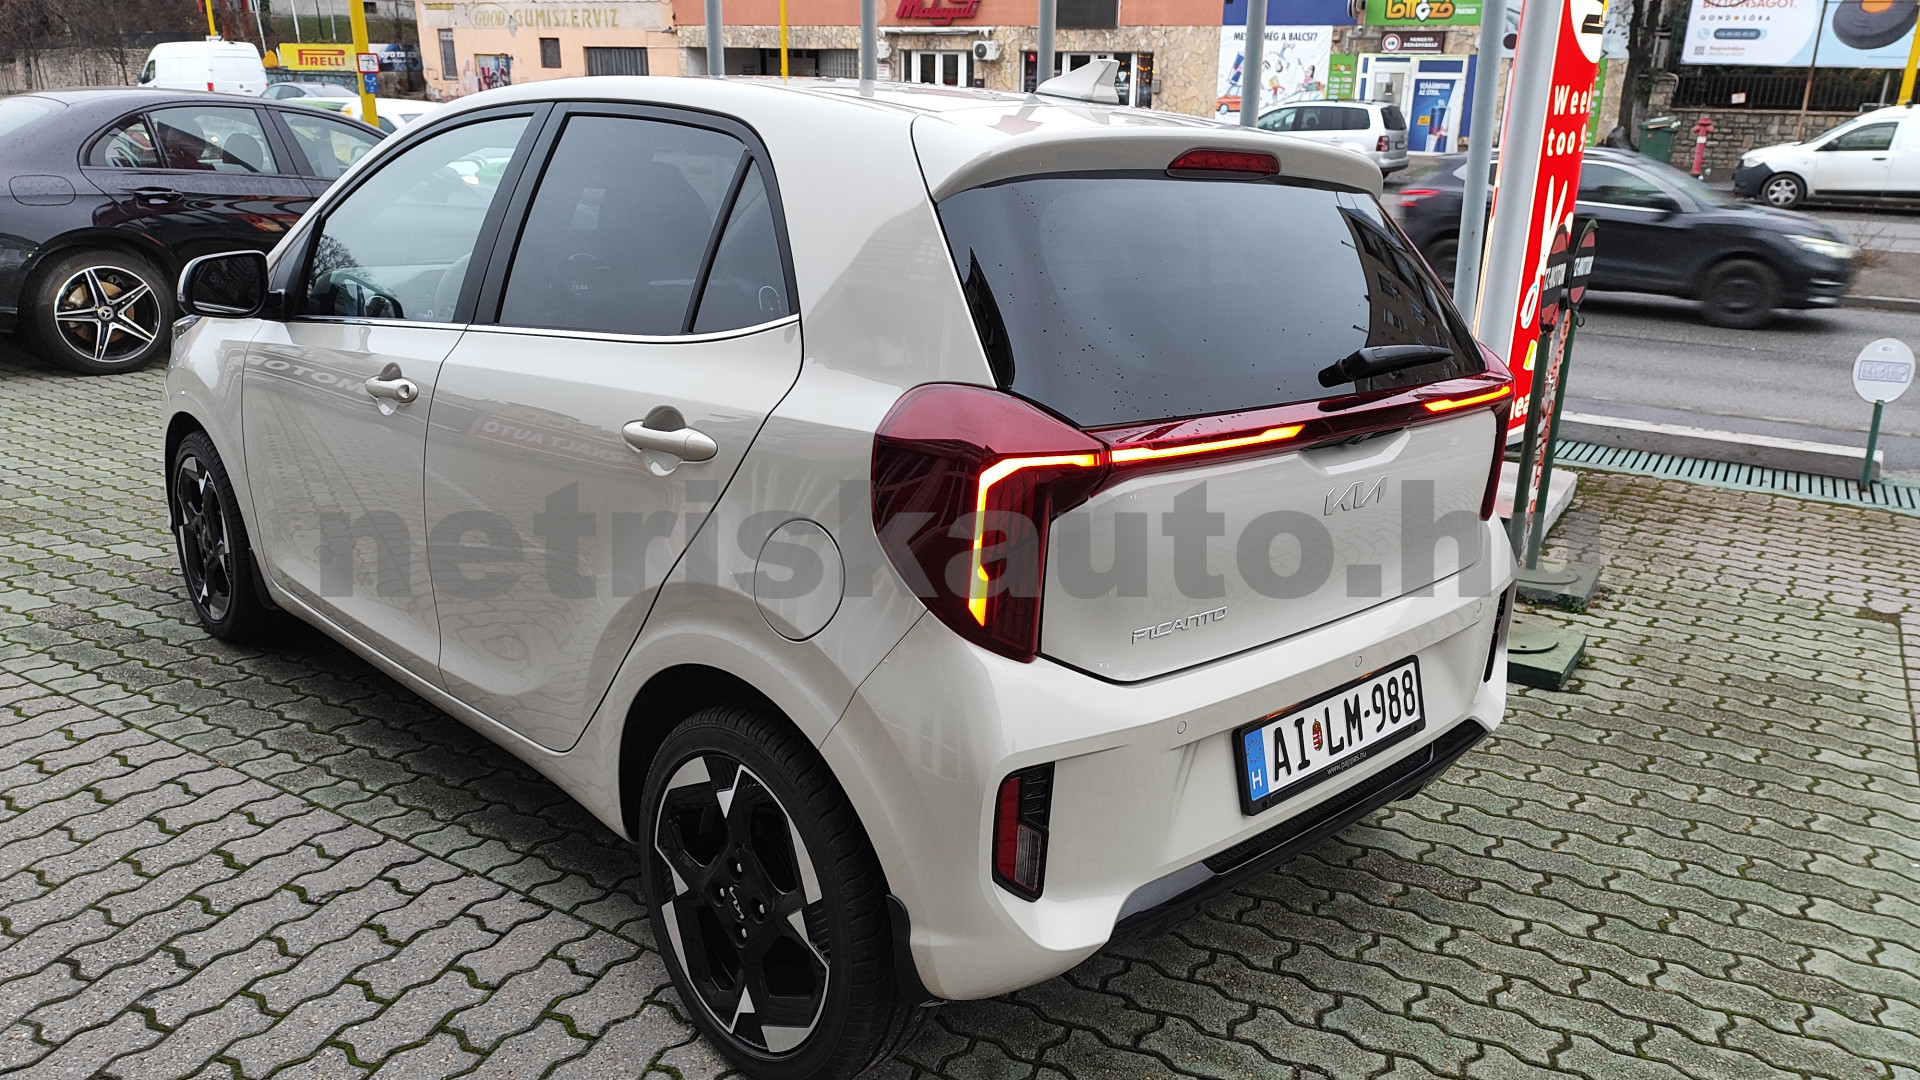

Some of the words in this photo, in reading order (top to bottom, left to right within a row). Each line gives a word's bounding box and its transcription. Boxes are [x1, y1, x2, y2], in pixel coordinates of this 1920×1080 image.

[474, 10, 506, 27] GOOD
[510, 8, 619, 28] GUMISZERVIZ
[1280, 32, 1287, 41] A
[1288, 32, 1319, 41] BALCSI?
[297, 48, 346, 67] PIRELLI
[1546, 127, 1576, 157] too
[1131, 604, 1228, 645] PICANTO
[1324, 669, 1417, 757] LM-988
[1251, 768, 1264, 791] H
